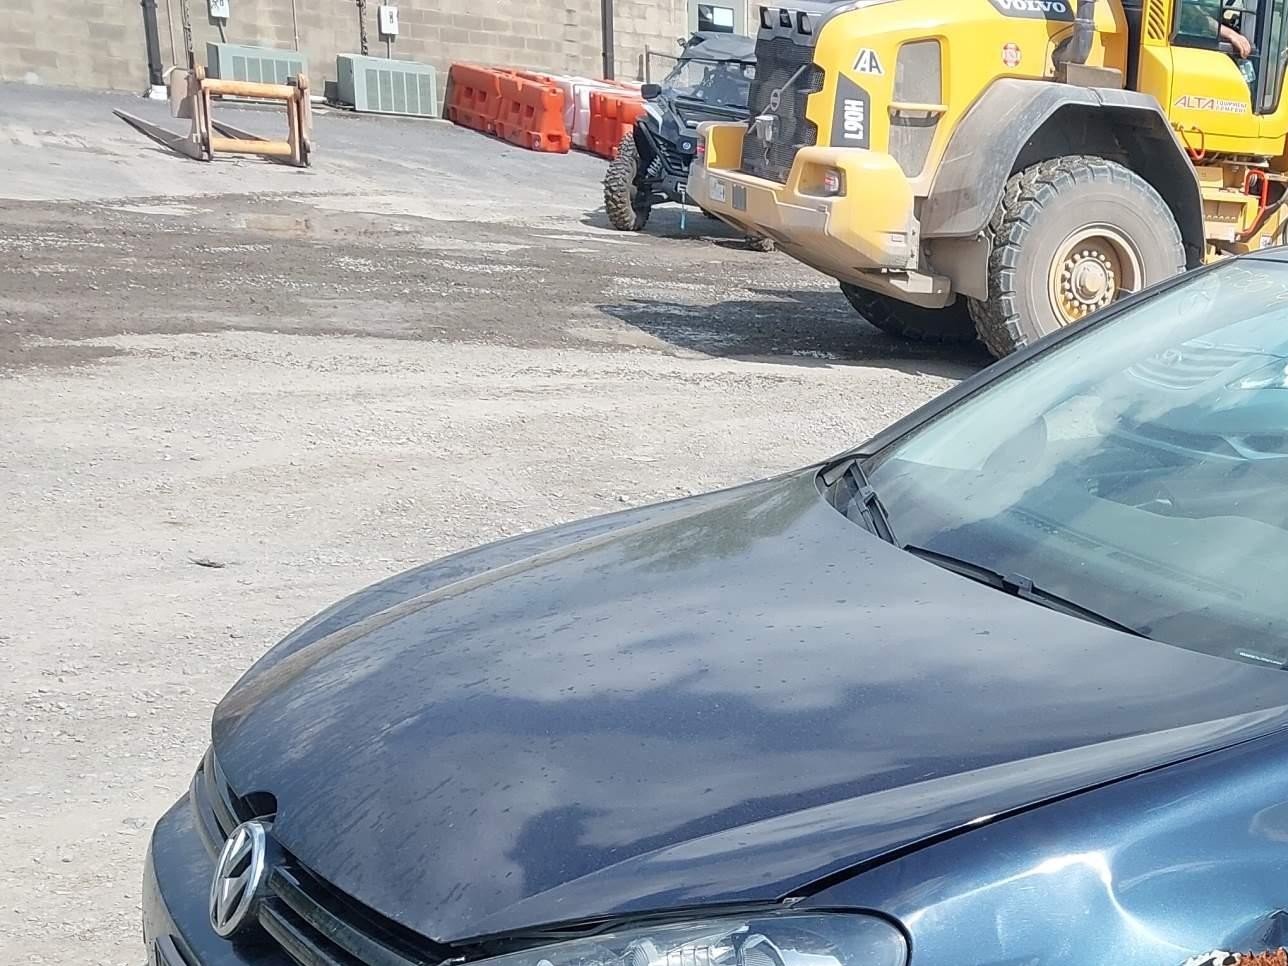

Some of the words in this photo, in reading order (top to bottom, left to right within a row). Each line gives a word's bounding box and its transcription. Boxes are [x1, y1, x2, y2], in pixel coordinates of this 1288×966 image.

[998, 0, 1066, 13] VOLVO
[1173, 95, 1215, 111] ALTA
[844, 99, 864, 140] L90H
